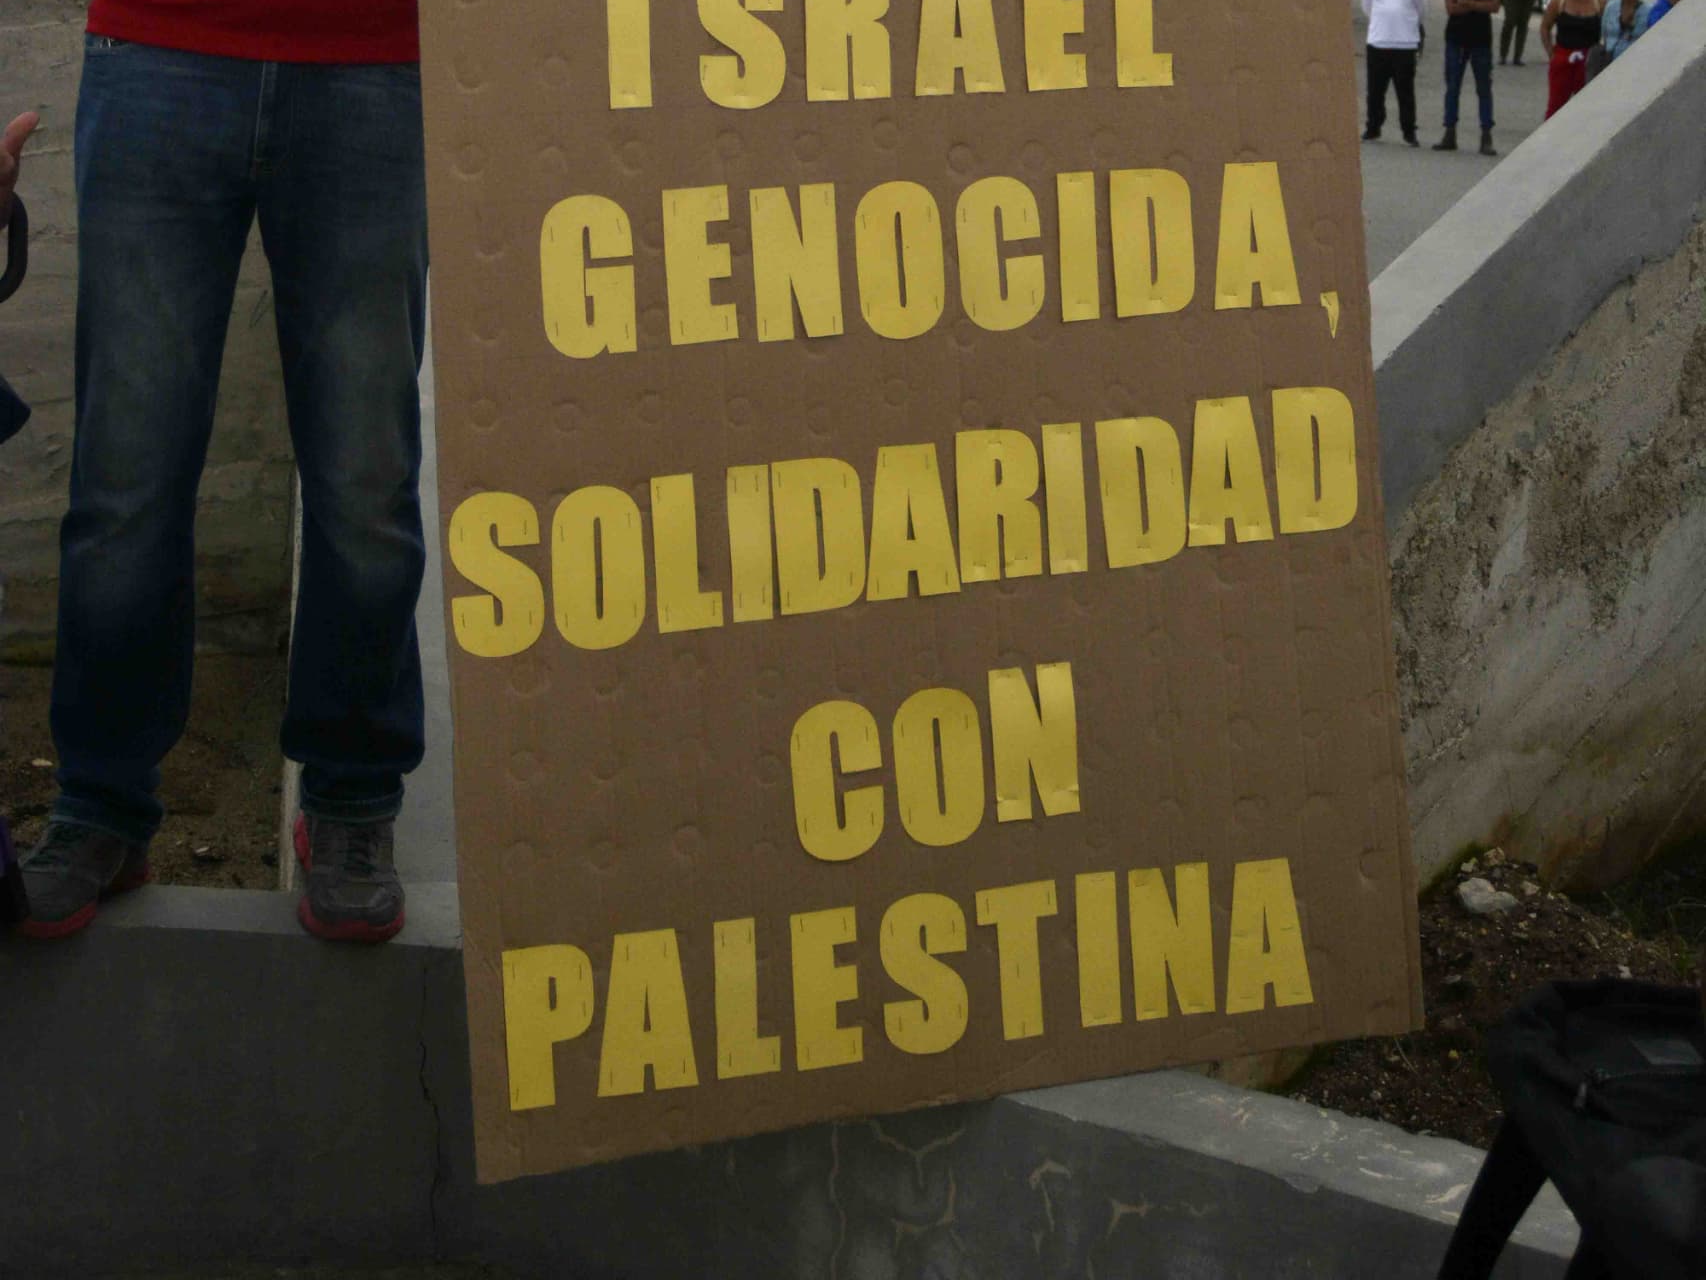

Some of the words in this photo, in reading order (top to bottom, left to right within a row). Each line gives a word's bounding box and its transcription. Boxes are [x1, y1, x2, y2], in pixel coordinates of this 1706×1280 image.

[447, 386, 1359, 658] SOLIDARIDAD
[790, 661, 1081, 861] CON
[502, 857, 1314, 1111] PALESTINA
